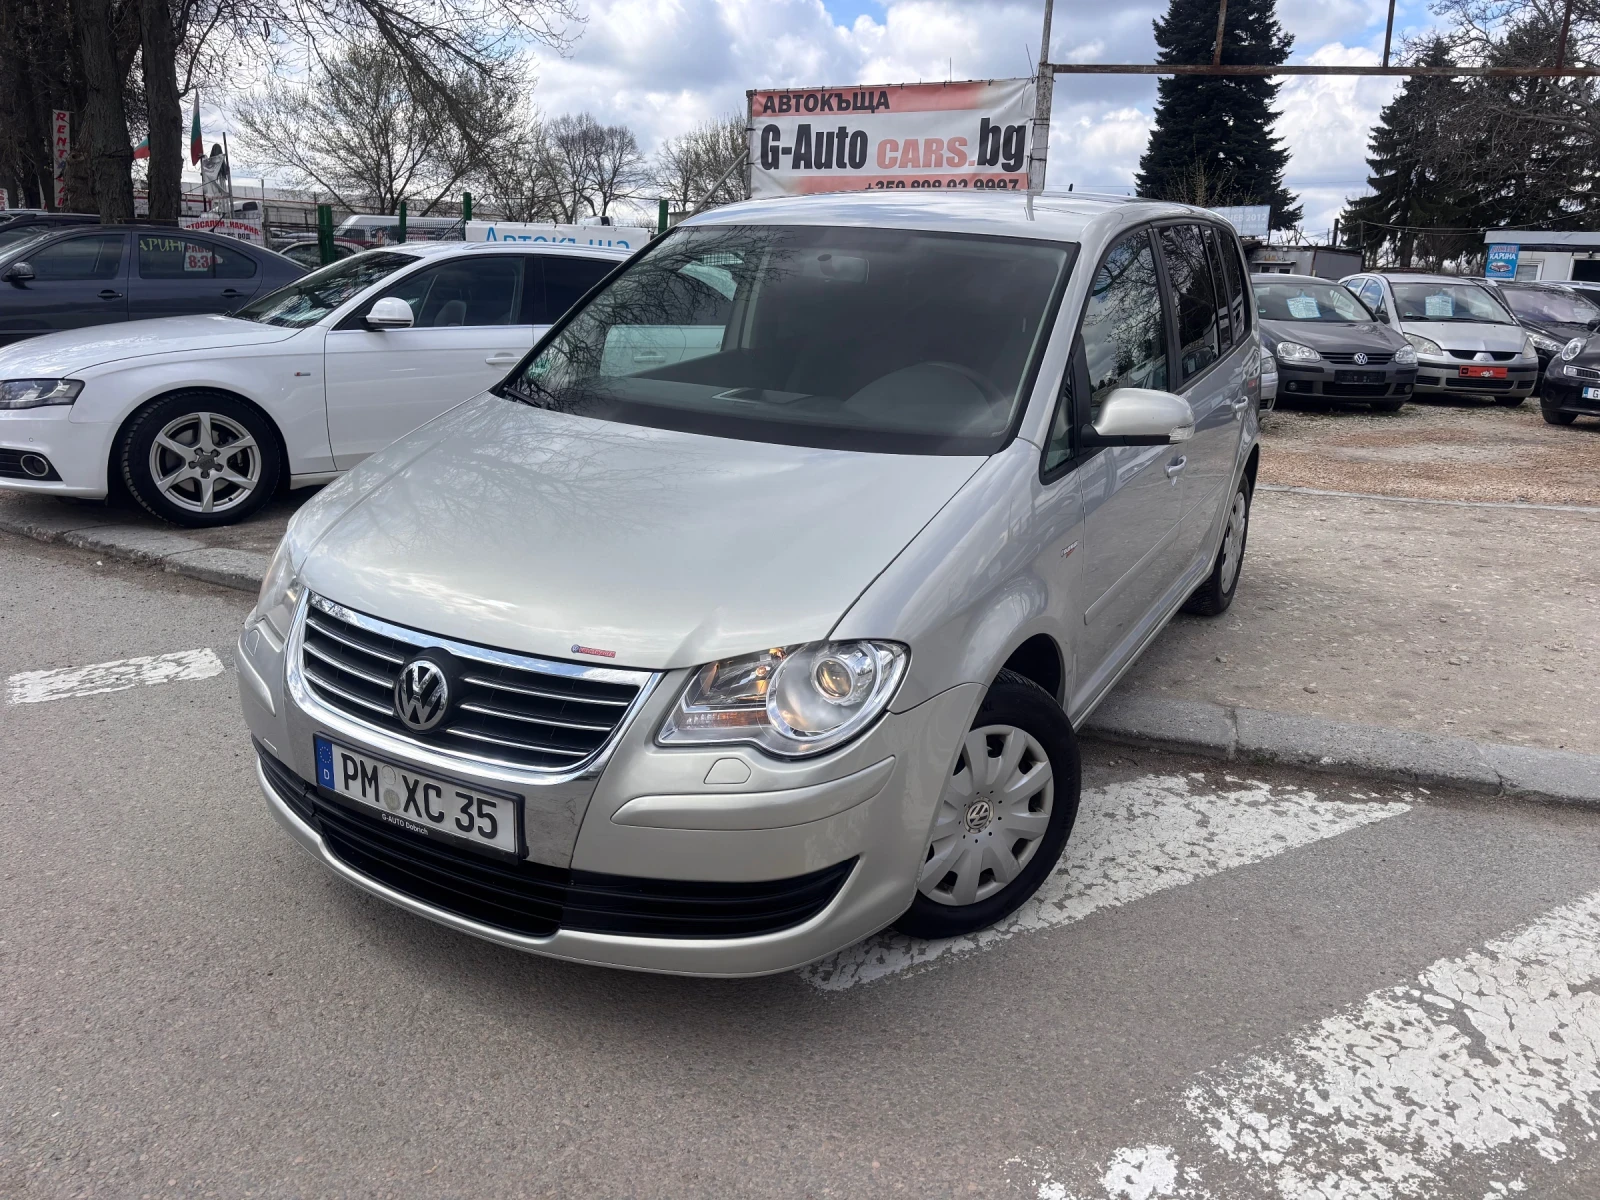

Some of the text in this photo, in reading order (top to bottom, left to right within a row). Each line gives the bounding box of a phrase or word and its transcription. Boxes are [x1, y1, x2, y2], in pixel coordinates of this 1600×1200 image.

[762, 91, 890, 113] АВТОКЪЩА
[761, 124, 868, 170] G-Auto
[1246, 213, 1267, 222] 2012
[341, 752, 497, 839] PM XC 35
[381, 813, 429, 836] G-AUTO Dobrich
